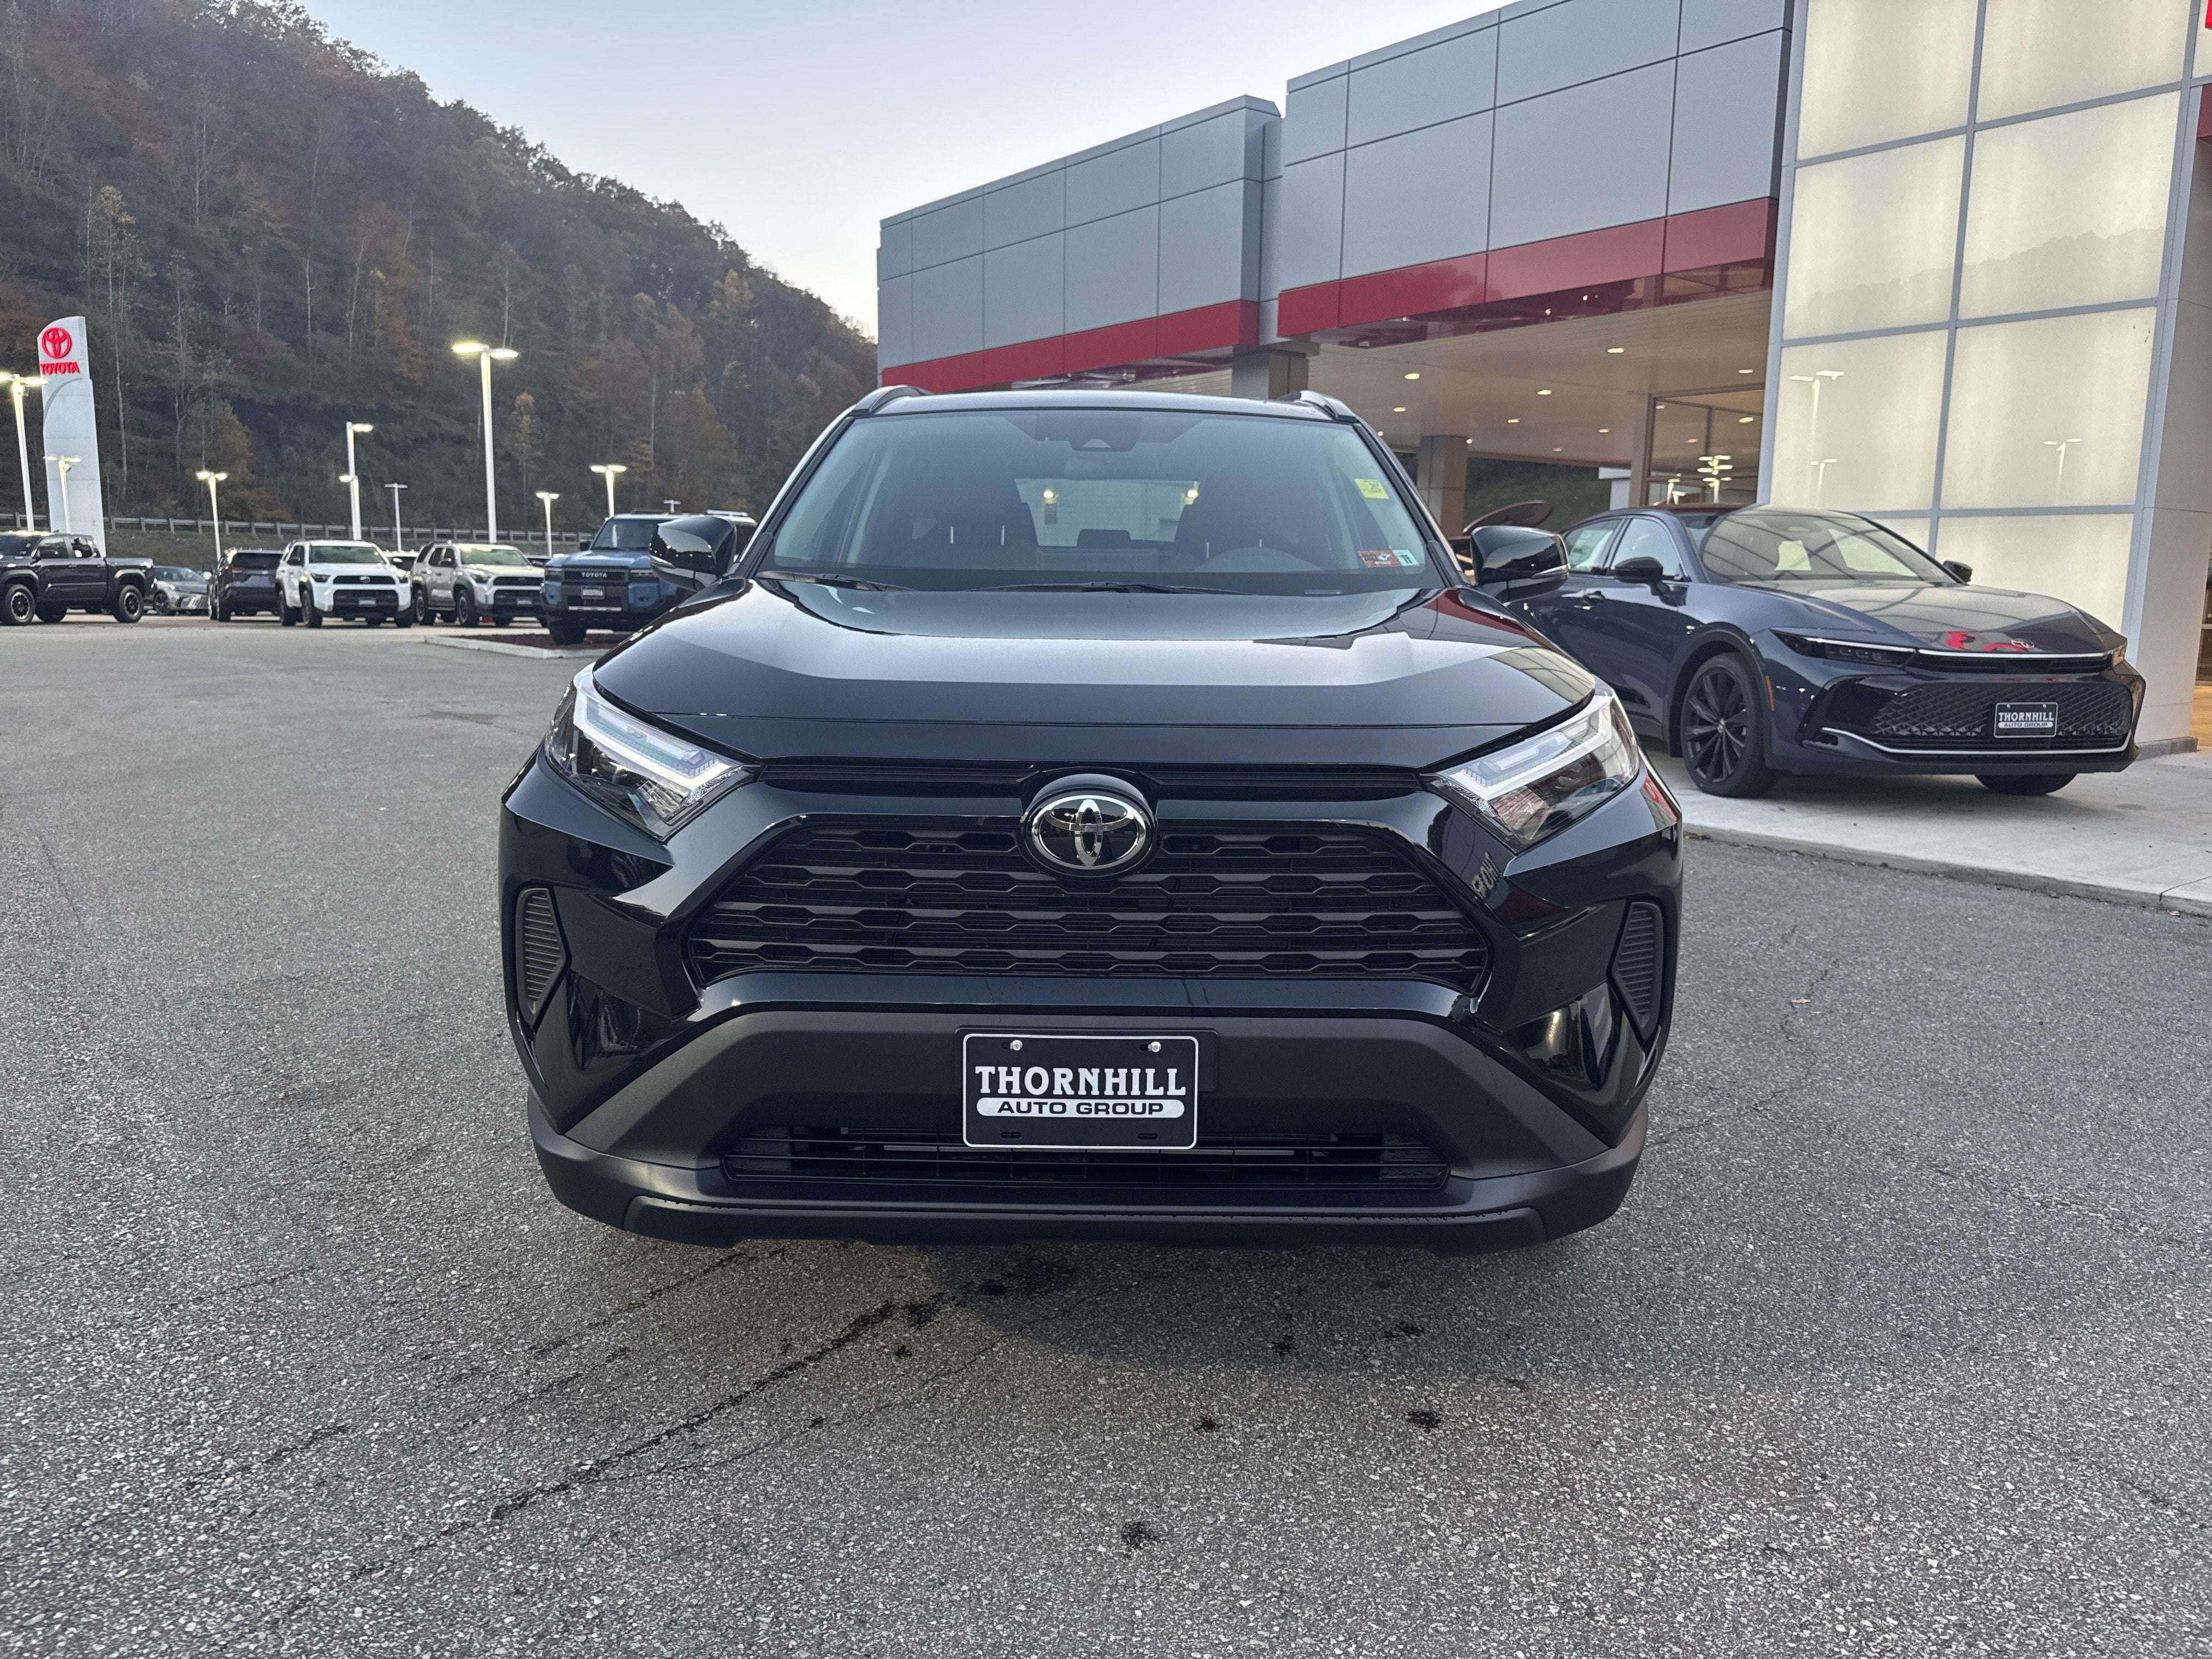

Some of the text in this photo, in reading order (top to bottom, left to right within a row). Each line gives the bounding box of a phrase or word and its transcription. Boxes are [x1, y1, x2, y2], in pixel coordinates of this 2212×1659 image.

[40, 362, 80, 375] TOYOTA
[1998, 712, 2054, 721] THORNHILL
[975, 1066, 1186, 1096] THORNHILL
[997, 1101, 1164, 1115] AUTO GROUP
